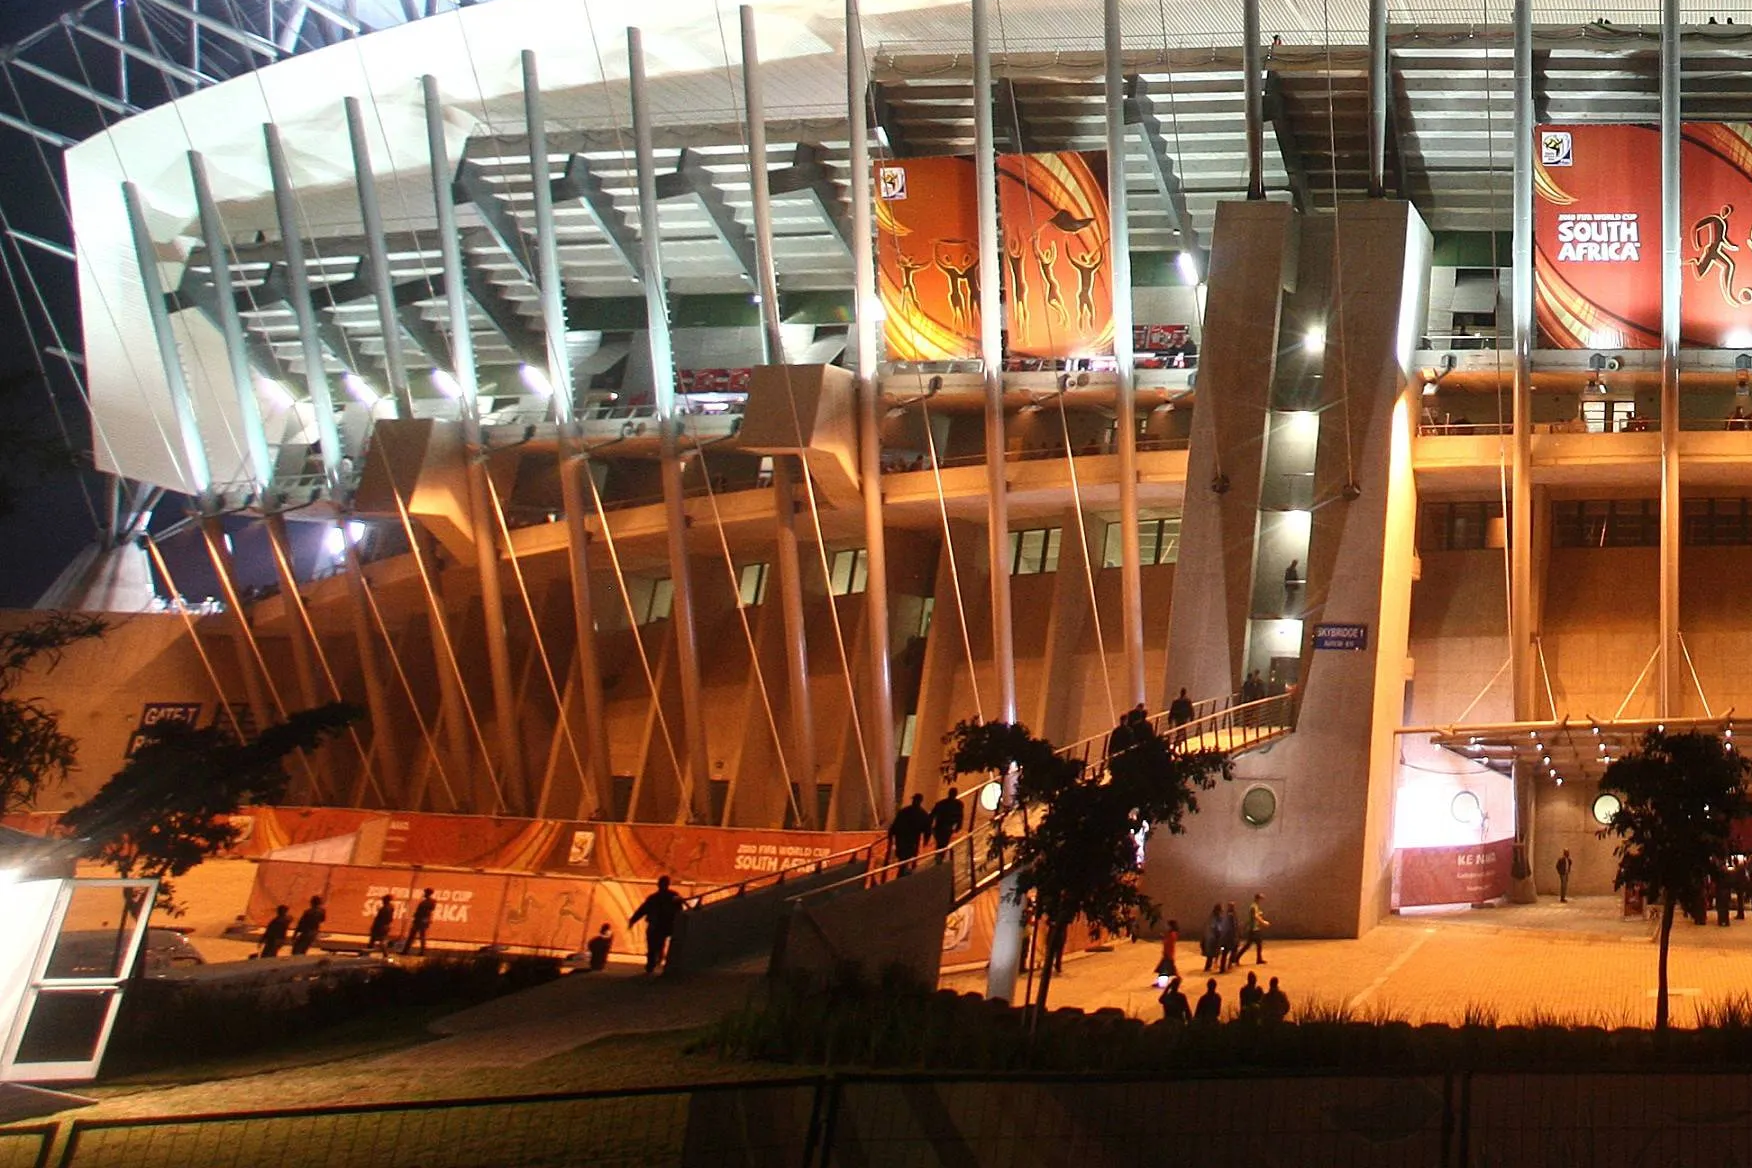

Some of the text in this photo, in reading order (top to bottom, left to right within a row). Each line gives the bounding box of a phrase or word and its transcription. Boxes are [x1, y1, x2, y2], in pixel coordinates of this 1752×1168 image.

[1557, 221, 1638, 242] SOUTH
[1557, 242, 1640, 261] AFRICA
[734, 855, 778, 872] SOUTH
